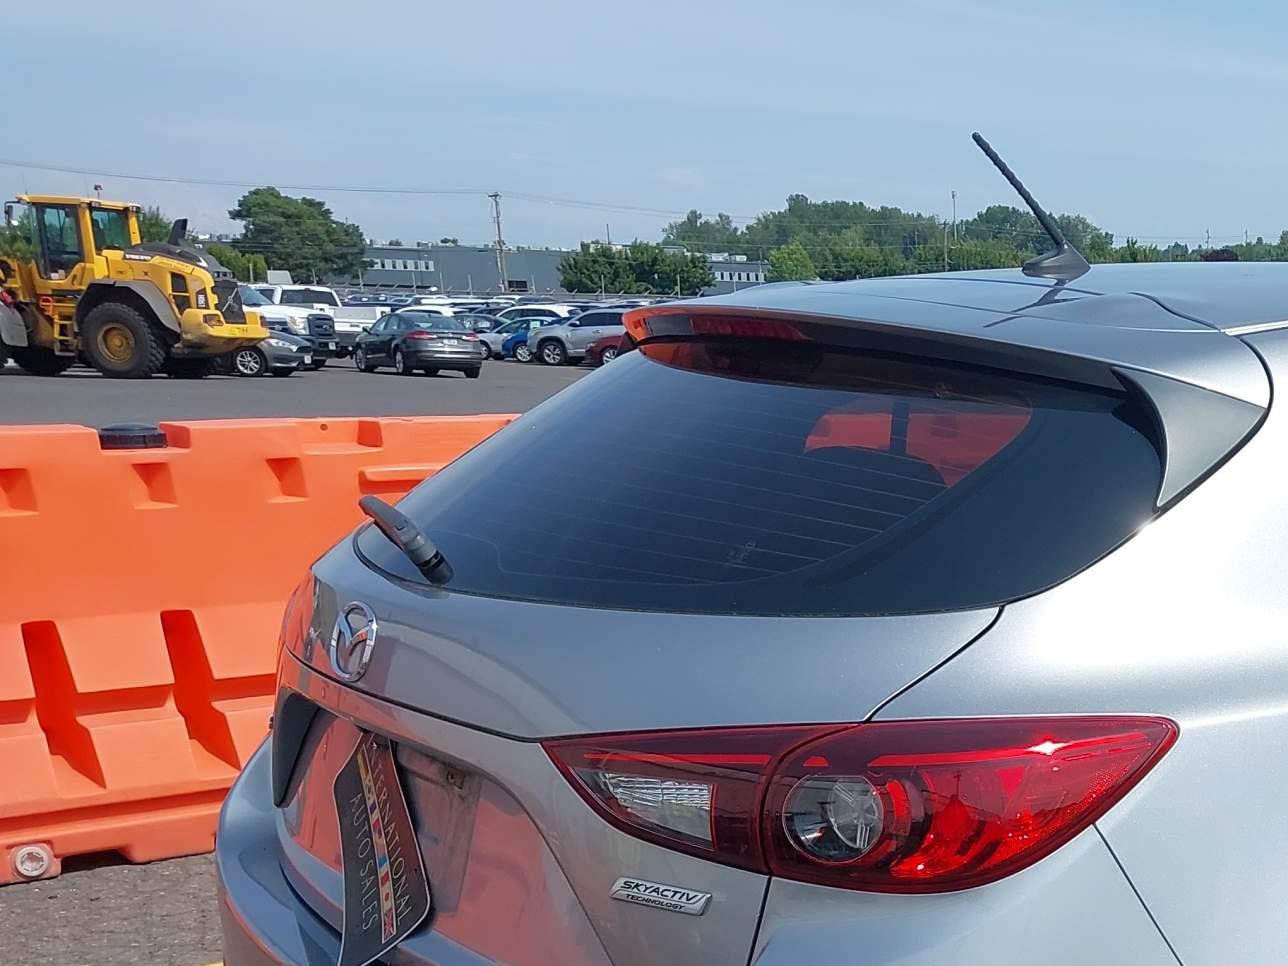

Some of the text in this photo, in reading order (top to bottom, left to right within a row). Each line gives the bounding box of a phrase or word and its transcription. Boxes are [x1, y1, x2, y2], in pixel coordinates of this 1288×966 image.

[350, 792, 379, 931] AUTO SALES
[366, 733, 413, 926] INTERNATIONAL
[620, 880, 700, 902] SKYACTIV
[625, 893, 686, 910] TECHNOLOGY
